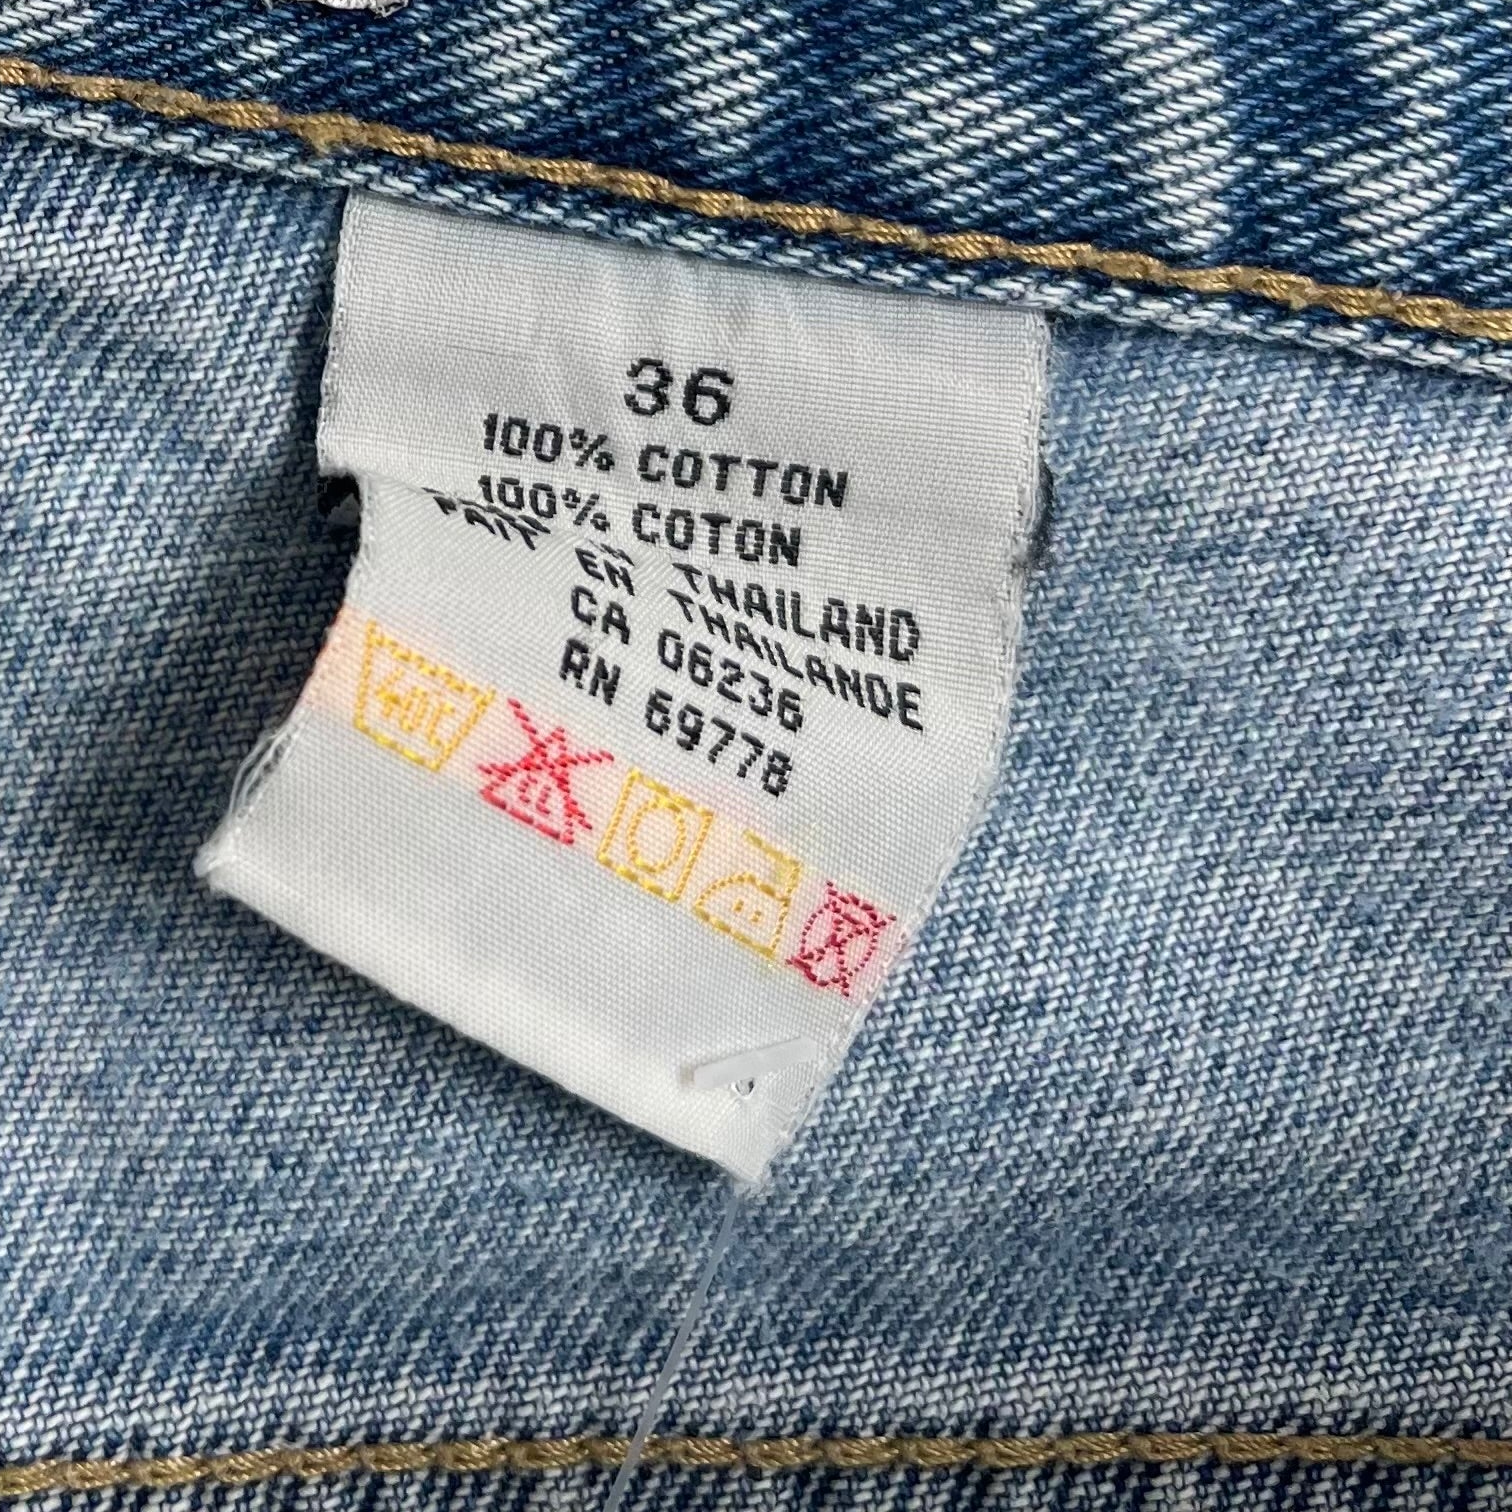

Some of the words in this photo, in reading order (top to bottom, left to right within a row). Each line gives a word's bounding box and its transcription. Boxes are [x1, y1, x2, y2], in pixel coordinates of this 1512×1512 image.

[624, 356, 735, 426] 36
[482, 413, 615, 474] 100%
[637, 444, 849, 508] COTTON
[478, 474, 611, 532] 100%
[632, 502, 802, 567] COTON
[570, 584, 631, 645] CA
[656, 627, 805, 733] 06236
[574, 546, 636, 597] EN
[666, 588, 924, 735] THAILANDE
[672, 561, 921, 662] THAILAND
[559, 637, 621, 706] RN
[645, 687, 794, 798] 69778
